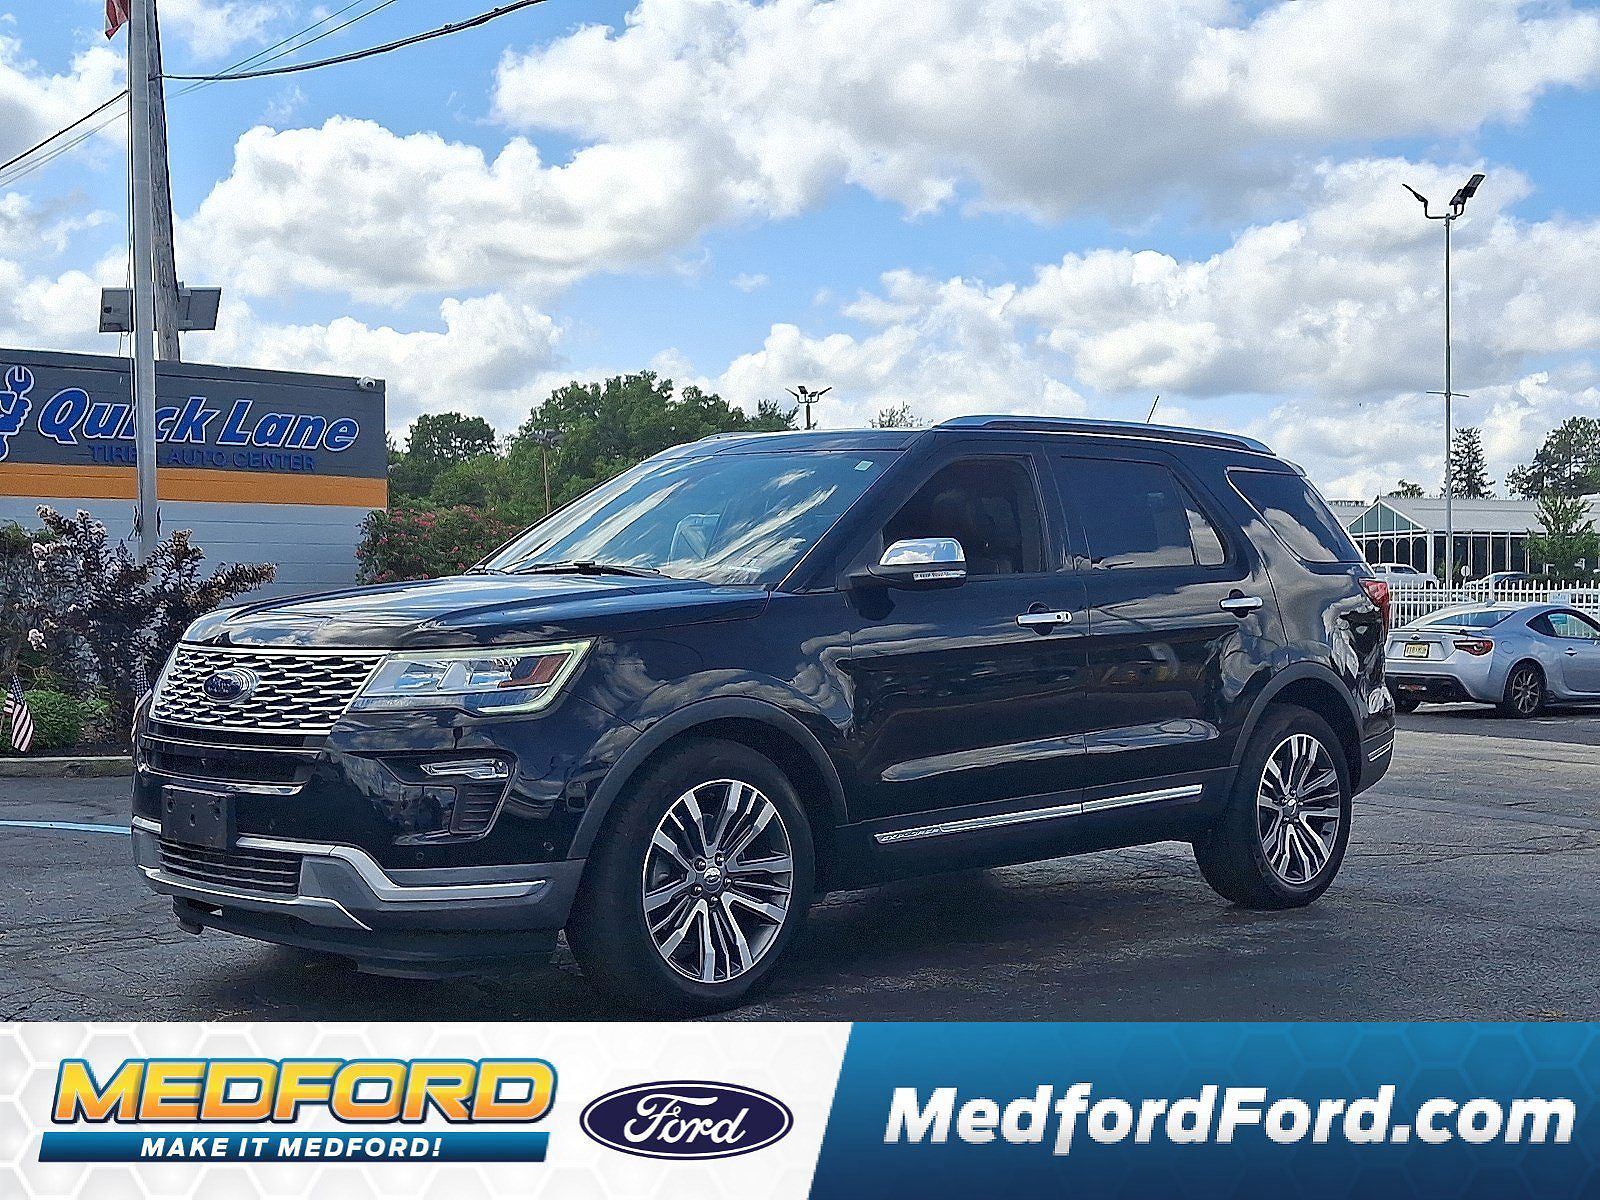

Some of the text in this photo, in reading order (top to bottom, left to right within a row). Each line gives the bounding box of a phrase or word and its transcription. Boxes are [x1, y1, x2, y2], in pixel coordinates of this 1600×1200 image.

[216, 400, 360, 452] Lane
[167, 447, 226, 468] AUTO
[232, 450, 315, 471] CENTER
